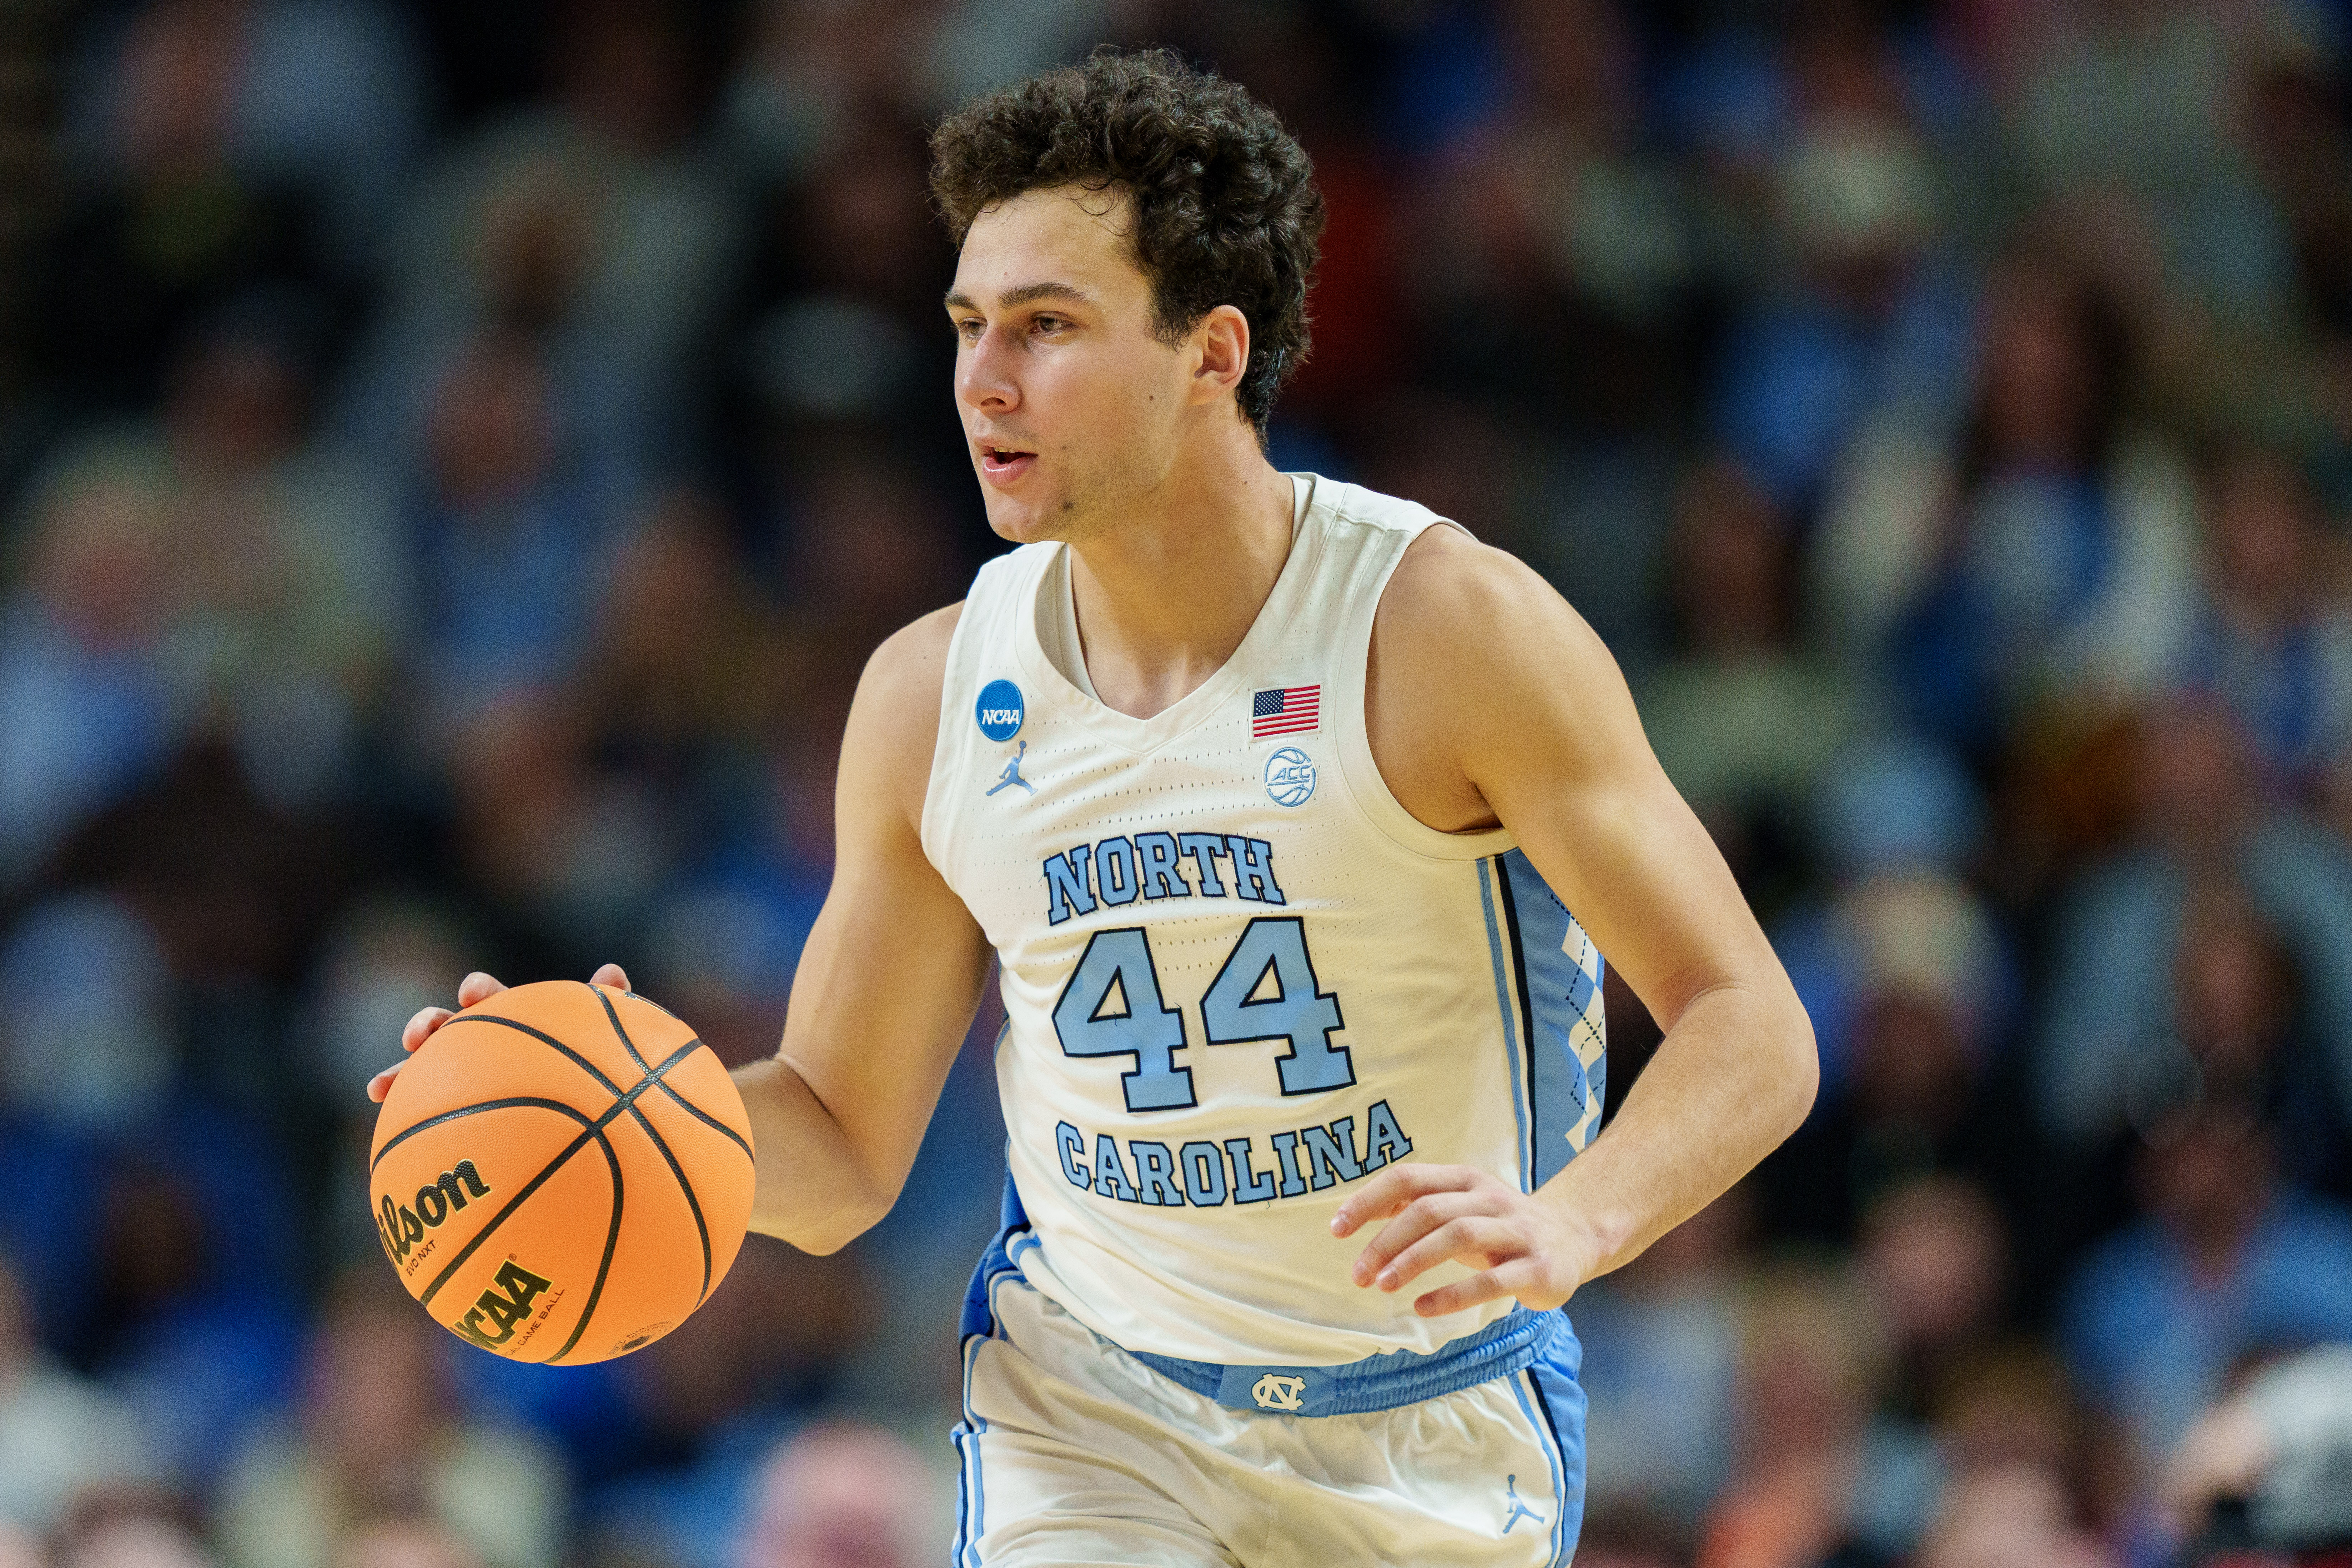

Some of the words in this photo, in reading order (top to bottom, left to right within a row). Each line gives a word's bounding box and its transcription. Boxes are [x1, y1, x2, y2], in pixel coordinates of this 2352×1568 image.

[982, 709, 1019, 725] NCAA
[1272, 764, 1312, 781] ACC
[1043, 831, 1286, 926] NORTH
[1051, 916, 1357, 1113] 44
[1055, 1099, 1414, 1207] CAROLINA
[376, 1159, 493, 1271] ilson
[406, 1259, 419, 1277] EVO
[418, 1240, 436, 1261] NXT
[538, 1289, 565, 1320] BALL
